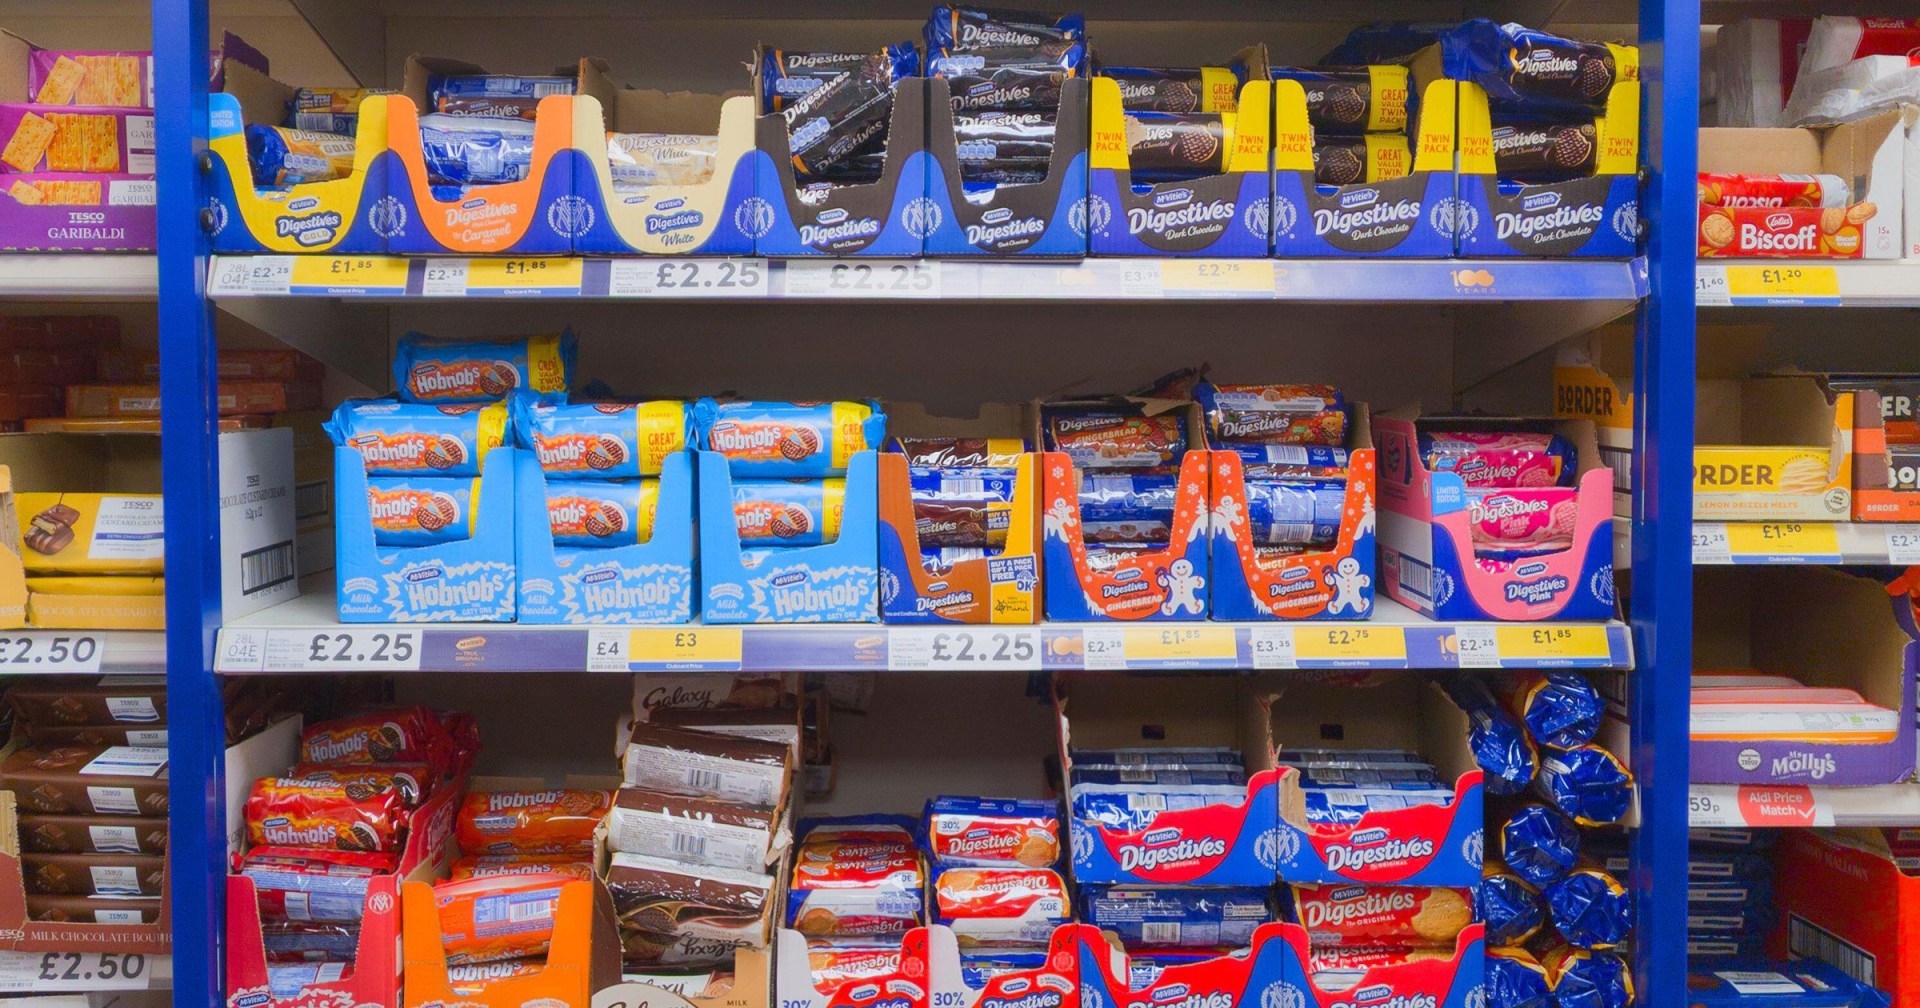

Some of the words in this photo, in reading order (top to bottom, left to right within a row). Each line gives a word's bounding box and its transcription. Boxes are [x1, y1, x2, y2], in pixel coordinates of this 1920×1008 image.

[962, 24, 1040, 46] Digestives
[788, 53, 867, 69] Digestives
[1518, 58, 1577, 77] Digestives
[783, 71, 850, 124] Digestives
[951, 86, 1030, 111] Digestives
[1097, 132, 1122, 141] TWIN
[1240, 135, 1264, 144] TWIN
[1282, 134, 1307, 142] TWIN
[1425, 134, 1450, 143] TWIN
[1464, 137, 1489, 146] TWIN
[1609, 137, 1634, 146] TWIN
[1097, 142, 1121, 151] PACK
[1238, 145, 1263, 154] PACK
[1282, 144, 1306, 152] PACK
[1424, 145, 1450, 153] PACK
[1464, 147, 1488, 156] PACK
[1608, 148, 1633, 156] PACK
[1377, 150, 1403, 160] GREAT
[69, 212, 105, 222] TESCO
[447, 204, 518, 227] Digestives
[649, 214, 700, 231] Digestives
[1128, 200, 1235, 234] Digestives
[1314, 200, 1420, 236] Digestives
[1496, 202, 1603, 240] Digestives
[278, 214, 338, 234] Digestives
[48, 228, 126, 240] GARIBALDI
[304, 230, 328, 240] GOLD
[462, 225, 511, 244] Caramel
[800, 218, 878, 246] Digestives
[968, 218, 1044, 245] Digestives
[1165, 228, 1187, 240] Dark
[1188, 224, 1223, 236] Chocolate
[1352, 228, 1372, 240] Dark
[1374, 224, 1410, 237] Chocolate
[1534, 231, 1555, 244] Dark
[1556, 227, 1592, 240] Chocolate
[1742, 224, 1817, 250] Biscoff
[662, 233, 695, 247] White
[252, 266, 289, 278] £2.25
[331, 260, 372, 274] £1.85
[506, 262, 546, 274] £1.85
[1198, 264, 1240, 277] £2.75
[428, 270, 464, 280] £2.25
[656, 262, 760, 288] £2.25
[830, 264, 933, 290] £2.25
[1762, 270, 1802, 284] £1.20
[416, 364, 480, 394] Hobnobs
[1558, 385, 1613, 416] BORDER
[1059, 418, 1124, 432] Digestives
[1223, 416, 1290, 437] Digestives
[648, 432, 676, 446] GREAT
[714, 426, 782, 450] Hobnobs
[1076, 428, 1137, 443] GINGERBREAD
[1436, 486, 1460, 495] LIMITED
[1472, 500, 1548, 524] Digestives
[1763, 524, 1802, 538] £1.50
[1693, 534, 1724, 546] £2.25
[991, 560, 1004, 568] BUY
[1014, 558, 1032, 566] PACK
[992, 572, 1014, 581] FREE
[406, 573, 504, 610] Hobnobs
[582, 575, 681, 612] Hobnobs
[1104, 581, 1149, 598] Digestives
[1271, 580, 1316, 596] Digestives
[1507, 579, 1566, 600] Digestives
[351, 594, 373, 603] Milk
[526, 595, 547, 604] Milk
[770, 577, 870, 616] Hobnobs
[916, 592, 972, 611] Digestives
[1272, 594, 1329, 610] GINGERBREAD
[1530, 591, 1552, 603] Pink
[341, 604, 383, 614] Chocolate
[520, 605, 558, 616] Chocolate
[716, 599, 737, 609] Milk
[1106, 596, 1163, 612] GINGERBREAD
[706, 609, 748, 620] Chocolate
[675, 633, 698, 646] £3
[1162, 630, 1200, 645] £1.85
[1328, 630, 1369, 644] £2.75
[1534, 630, 1572, 644] £1.85
[228, 644, 256, 657] 04E
[309, 633, 412, 662] £2.25
[597, 642, 619, 656] £4
[932, 633, 1034, 661] £2.25
[1088, 641, 1122, 652] £2.25
[1256, 640, 1290, 652] £3.35
[1460, 639, 1494, 650] £2.25
[642, 686, 714, 709] Galaxy
[308, 731, 368, 763] Hobnobs
[1771, 753, 1836, 780] Molly's
[489, 790, 564, 812] Hobnobs
[1750, 792, 1772, 803] Aldi
[1774, 792, 1804, 803] Price
[1690, 796, 1720, 814] 59p
[1760, 804, 1796, 816] Match
[942, 820, 960, 830] 30%
[264, 825, 336, 846] Hobnobs
[949, 834, 1022, 855] Digestives
[1119, 835, 1226, 872] Digestives
[1326, 836, 1432, 872] Digestives
[1172, 860, 1200, 868] ORIGINAL
[1378, 860, 1408, 868] ORIGINAL
[1040, 902, 1058, 911] 30%
[1306, 892, 1415, 928] Digestives
[1357, 914, 1396, 926] ORIGINAL
[30, 931, 58, 941] MILK
[60, 932, 130, 942] CHOCOLATE
[1352, 954, 1390, 963] ORIGINAL
[38, 952, 145, 980] £2.50
[934, 992, 964, 1006] 30%
